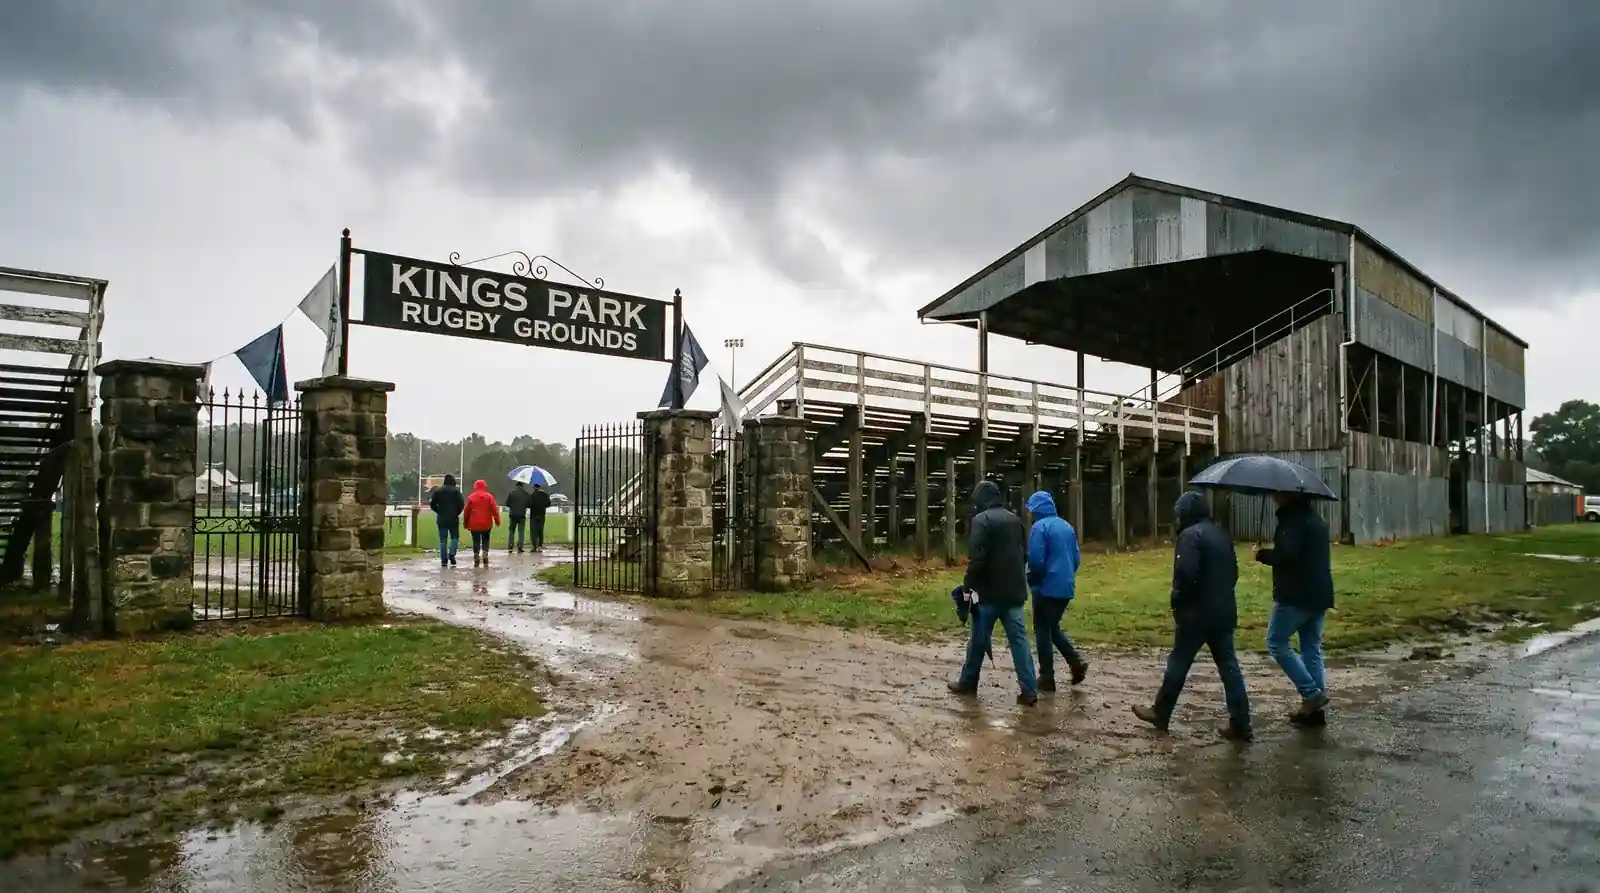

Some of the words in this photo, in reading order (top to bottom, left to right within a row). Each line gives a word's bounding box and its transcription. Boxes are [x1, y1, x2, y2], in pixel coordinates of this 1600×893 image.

[391, 263, 528, 312] KINGS
[547, 288, 647, 331] PARK
[402, 300, 501, 333] RUGBY
[513, 317, 637, 351] GROUNDS
